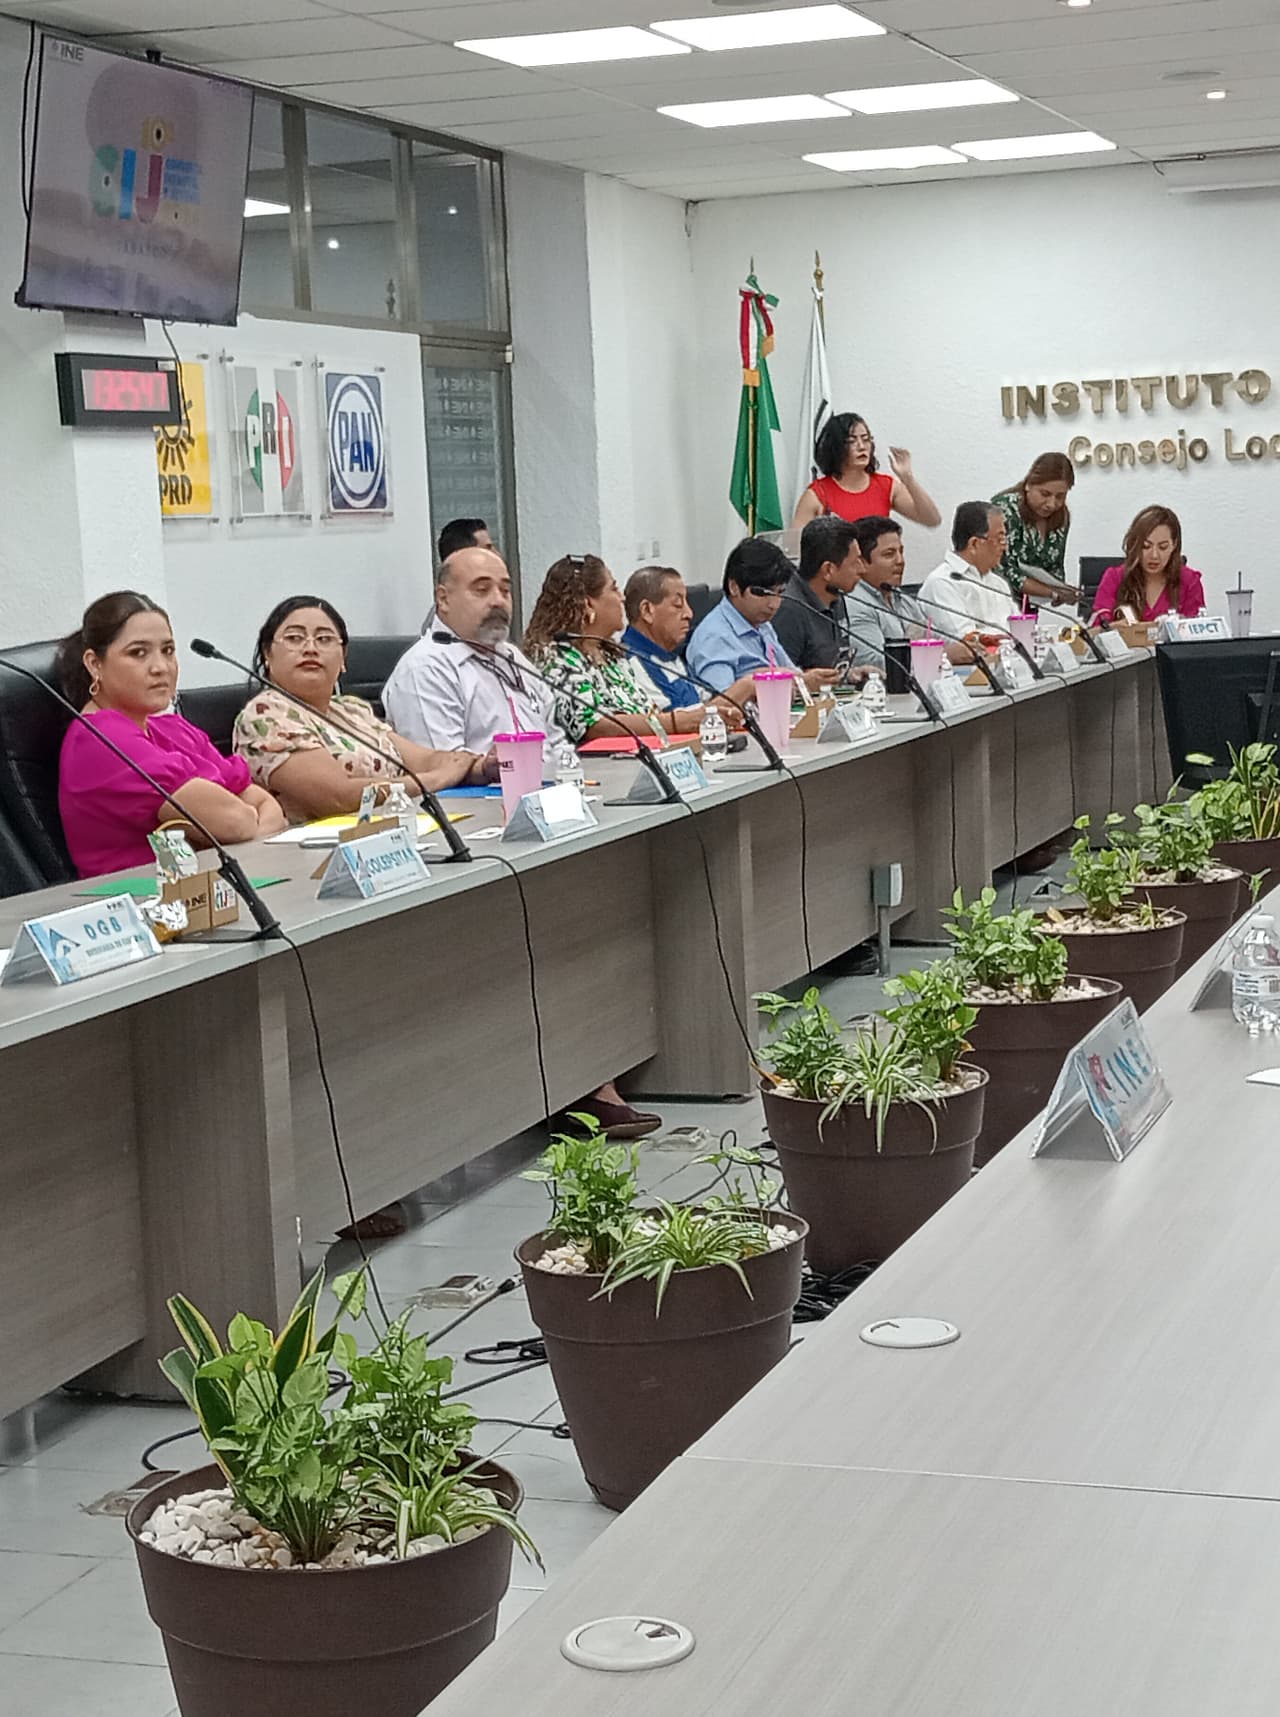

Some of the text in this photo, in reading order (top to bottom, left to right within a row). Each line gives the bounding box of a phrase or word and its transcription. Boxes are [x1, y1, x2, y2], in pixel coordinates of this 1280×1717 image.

[1001, 369, 1272, 419] INSTITUTO
[245, 402, 294, 469] PRI
[338, 411, 376, 473] PAN
[1068, 429, 1209, 470] Consejo
[159, 474, 193, 505] PRD
[1188, 622, 1220, 635] IEPCT
